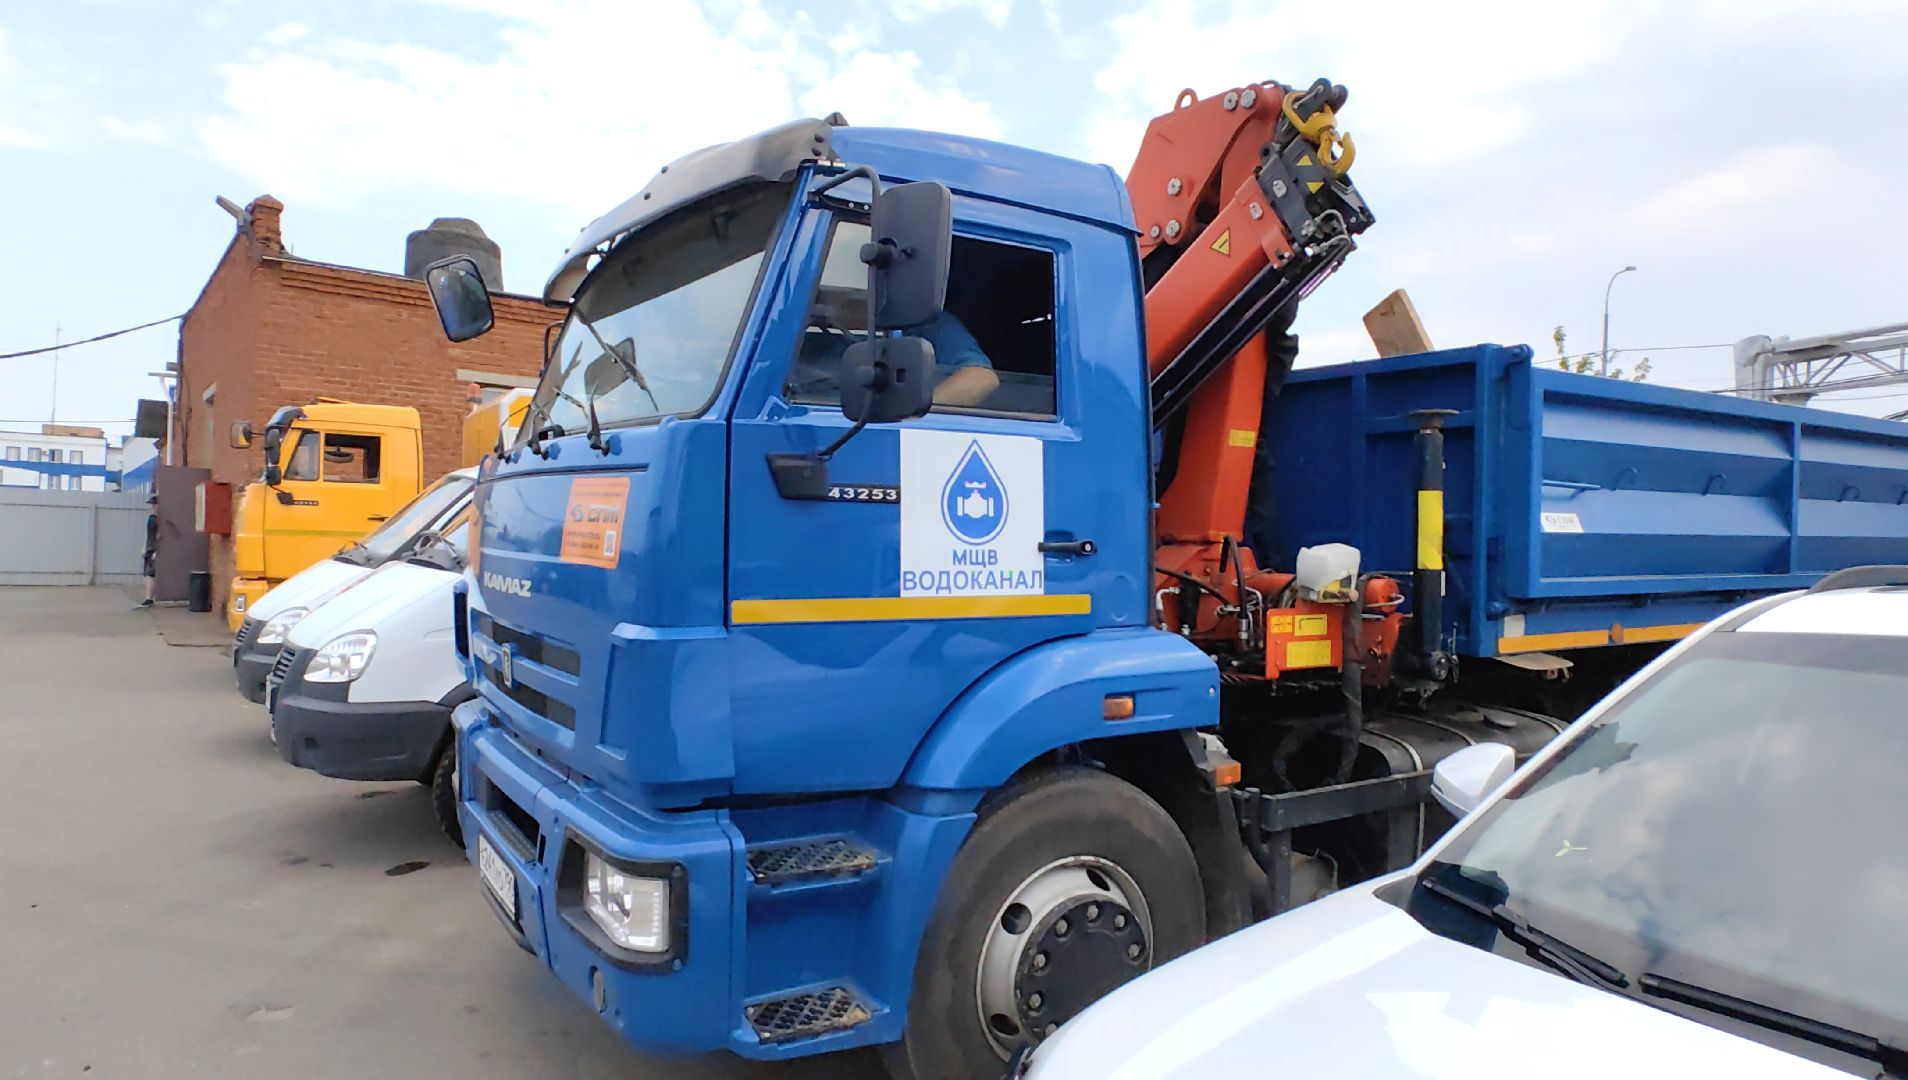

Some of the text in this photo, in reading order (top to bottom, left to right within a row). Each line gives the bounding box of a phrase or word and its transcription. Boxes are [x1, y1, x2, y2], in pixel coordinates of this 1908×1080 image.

[828, 486, 897, 500] 43253
[952, 549, 998, 568] МЩВ
[484, 570, 532, 598] KAMAZ
[902, 569, 1043, 595] ВОДОКАНАЛ
